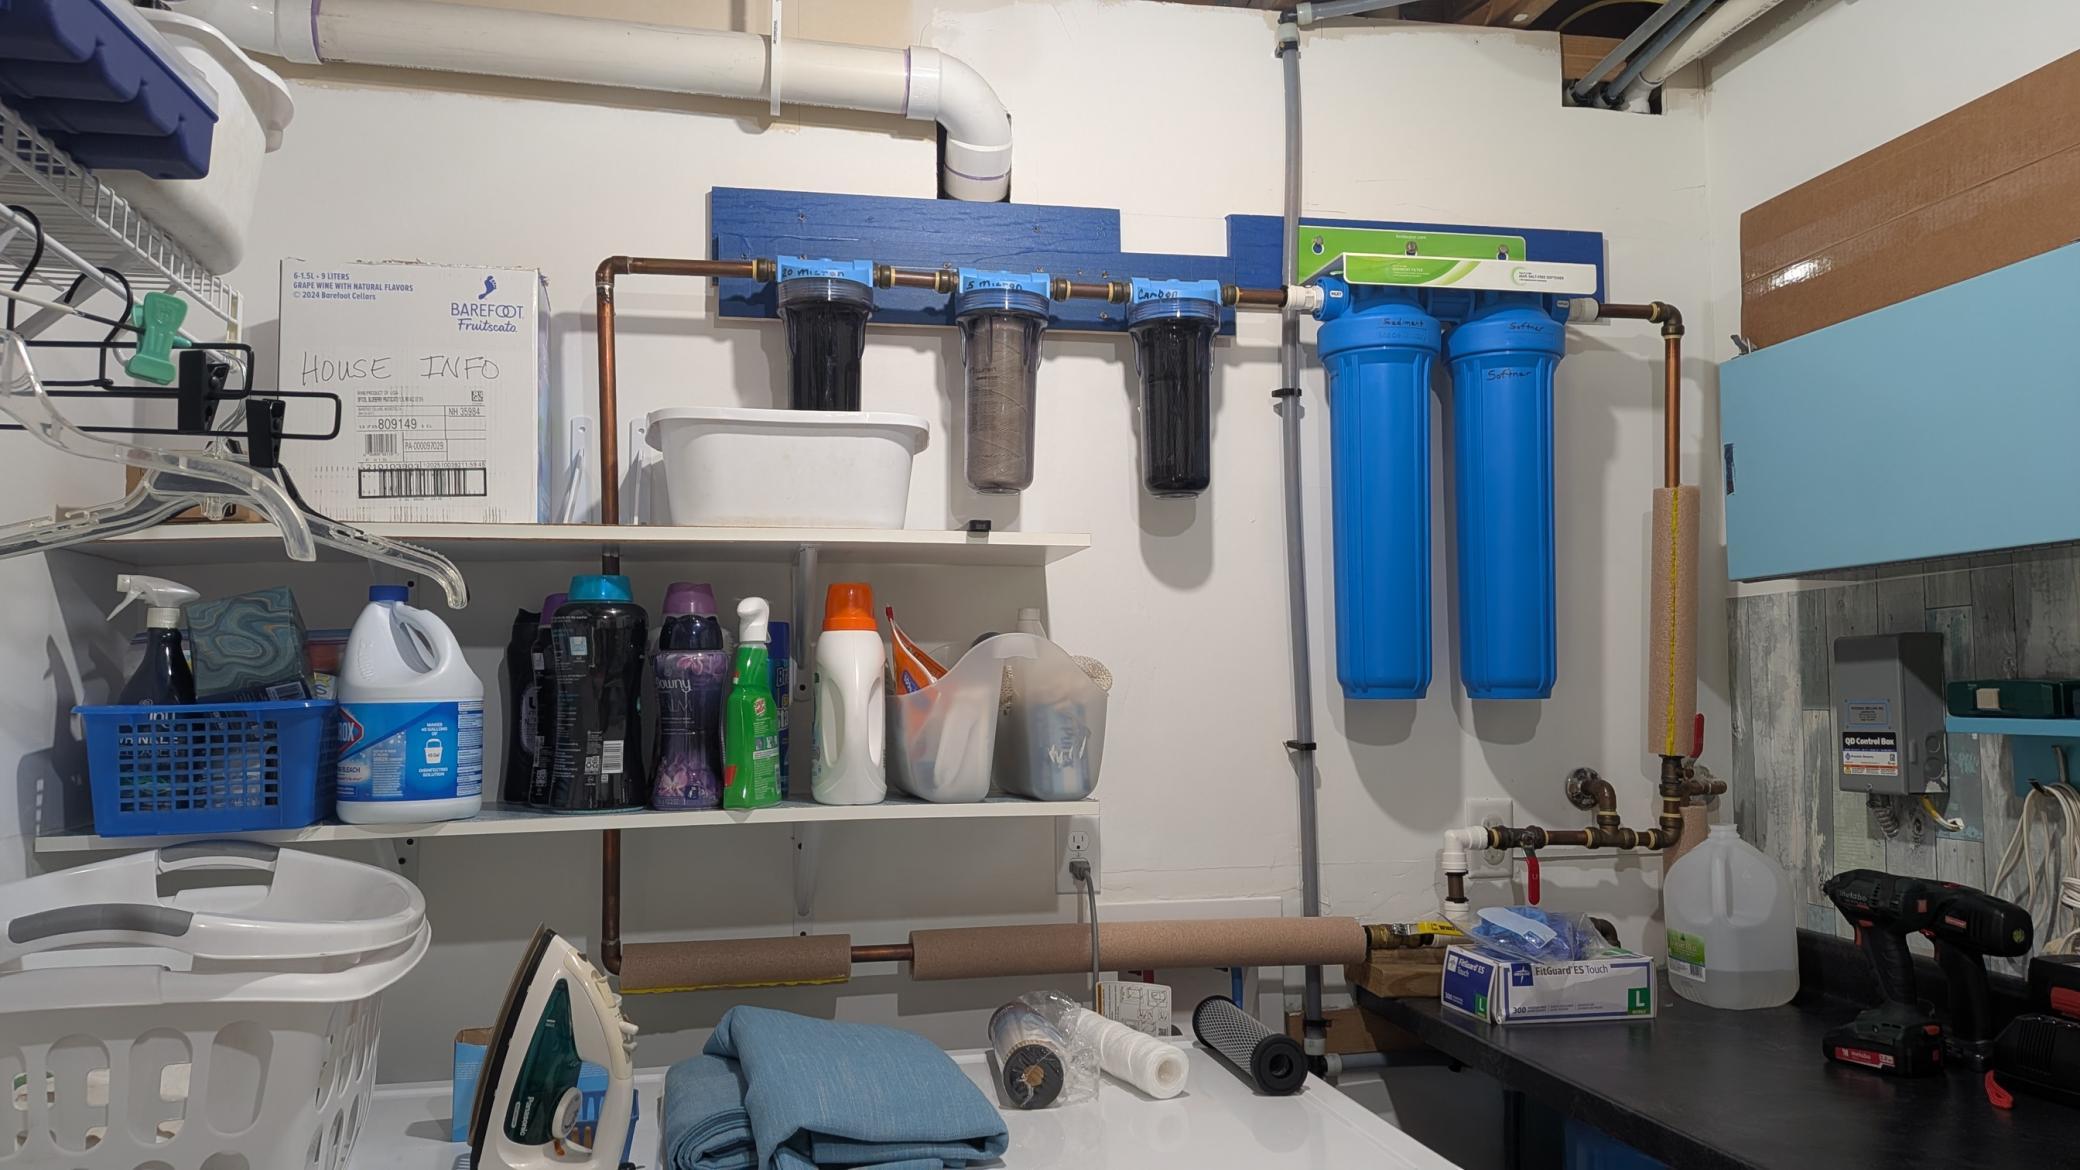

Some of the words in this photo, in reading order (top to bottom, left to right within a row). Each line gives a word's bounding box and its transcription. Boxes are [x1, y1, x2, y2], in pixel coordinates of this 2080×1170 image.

[321, 272, 326, 280] 9
[293, 281, 315, 289] GRAPE
[334, 282, 352, 290] WITH
[353, 283, 382, 291] NATURAL
[384, 283, 413, 292] FLAVORS
[966, 280, 974, 290] 5
[321, 291, 351, 299] Barefoot
[352, 292, 376, 300] Cellars
[451, 302, 523, 319] BAREFOOT
[457, 317, 517, 332] Fruitscato
[301, 351, 392, 386] HOUSE
[420, 355, 499, 380] INFO
[378, 418, 417, 430] 809149
[1845, 737, 1855, 746] QD
[1856, 737, 1880, 745] Control
[1881, 737, 1895, 745] Box
[1478, 966, 1486, 975] ES
[1535, 966, 1571, 976] FitGuard
[1574, 965, 1584, 975] ES
[1586, 965, 1608, 975] Touch
[1635, 990, 1645, 1007] L
[1479, 997, 1485, 1012] L
[1512, 1006, 1526, 1014] 300
[519, 1096, 534, 1137] Panasonic
